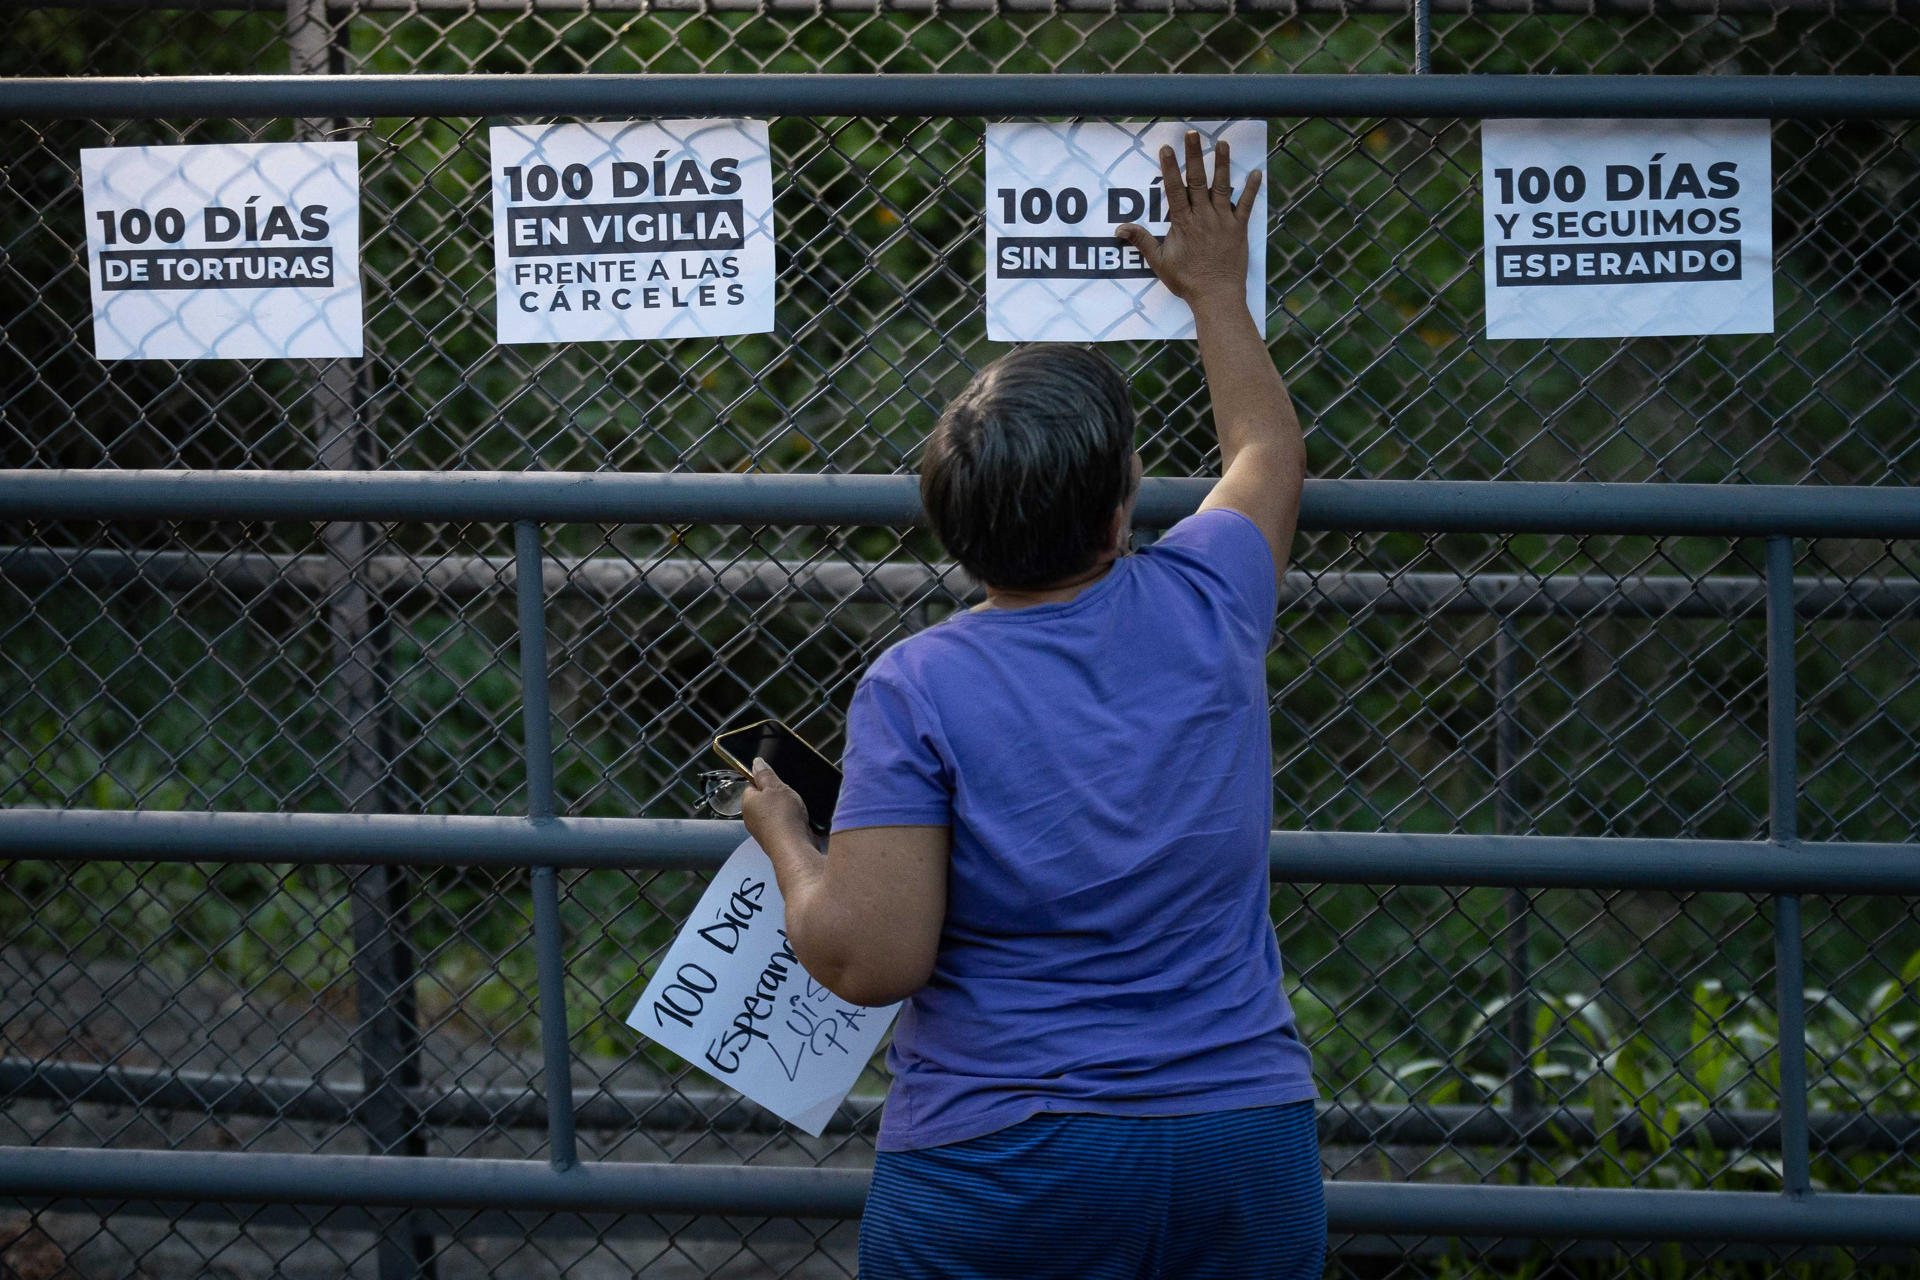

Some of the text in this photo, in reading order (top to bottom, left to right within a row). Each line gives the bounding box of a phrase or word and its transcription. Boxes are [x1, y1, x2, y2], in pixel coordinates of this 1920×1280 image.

[503, 150, 742, 202] 100 DÍAS
[1494, 152, 1740, 205] 100 DÍAS
[997, 176, 1236, 225] 100 DÍ
[96, 195, 330, 245] 100 DÍAS
[514, 211, 740, 247] EN VIGILIA
[1494, 207, 1742, 240] Y SEGUIMOS
[104, 255, 330, 283] DE TORTURAS
[515, 256, 740, 285] FRENTE A LAS
[1001, 245, 1151, 270] SIN LIBE
[1503, 249, 1736, 279] ESPERANDO
[519, 284, 745, 313] CÁRCELES
[652, 877, 766, 1029] 100 Días
